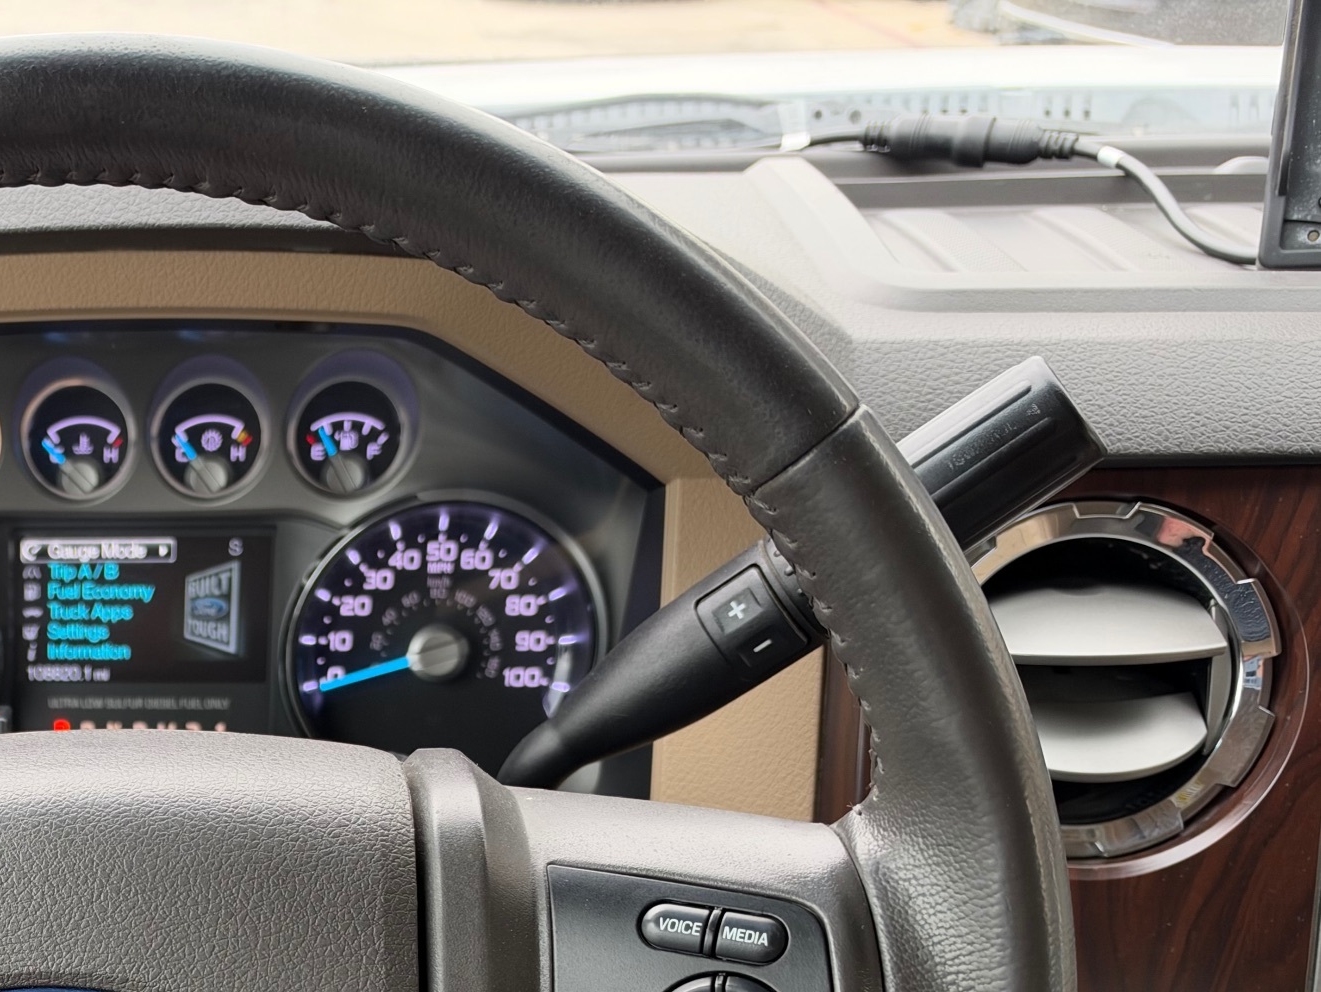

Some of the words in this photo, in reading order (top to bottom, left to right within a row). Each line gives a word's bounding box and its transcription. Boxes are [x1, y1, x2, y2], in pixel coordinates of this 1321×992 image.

[103, 446, 119, 463] H
[230, 444, 246, 462] H
[310, 443, 326, 461] E
[366, 442, 382, 460] F
[47, 542, 100, 562] Gauge
[101, 541, 148, 560] Mode
[228, 537, 244, 556] S
[426, 540, 459, 562] 50
[388, 549, 422, 570] 40
[427, 561, 455, 574] MPH
[460, 549, 494, 570] 60
[47, 562, 77, 582] Trip
[78, 562, 92, 580] A
[104, 562, 120, 580] B
[363, 568, 395, 590] 30
[488, 568, 519, 589] 70
[47, 582, 81, 600] Fuel
[81, 582, 156, 603] Economy
[188, 571, 232, 596] BUILT
[47, 601, 90, 620] Truck
[90, 602, 134, 623] Apps
[340, 595, 373, 616] 20
[505, 594, 539, 616] 80
[47, 621, 110, 643] Settings
[187, 619, 229, 643] TOUGH
[328, 630, 354, 652] 10
[515, 630, 548, 652] 90
[47, 642, 131, 660] Information
[503, 666, 544, 688] 100
[658, 916, 703, 936] VOICE
[722, 925, 769, 947] MEDIA
